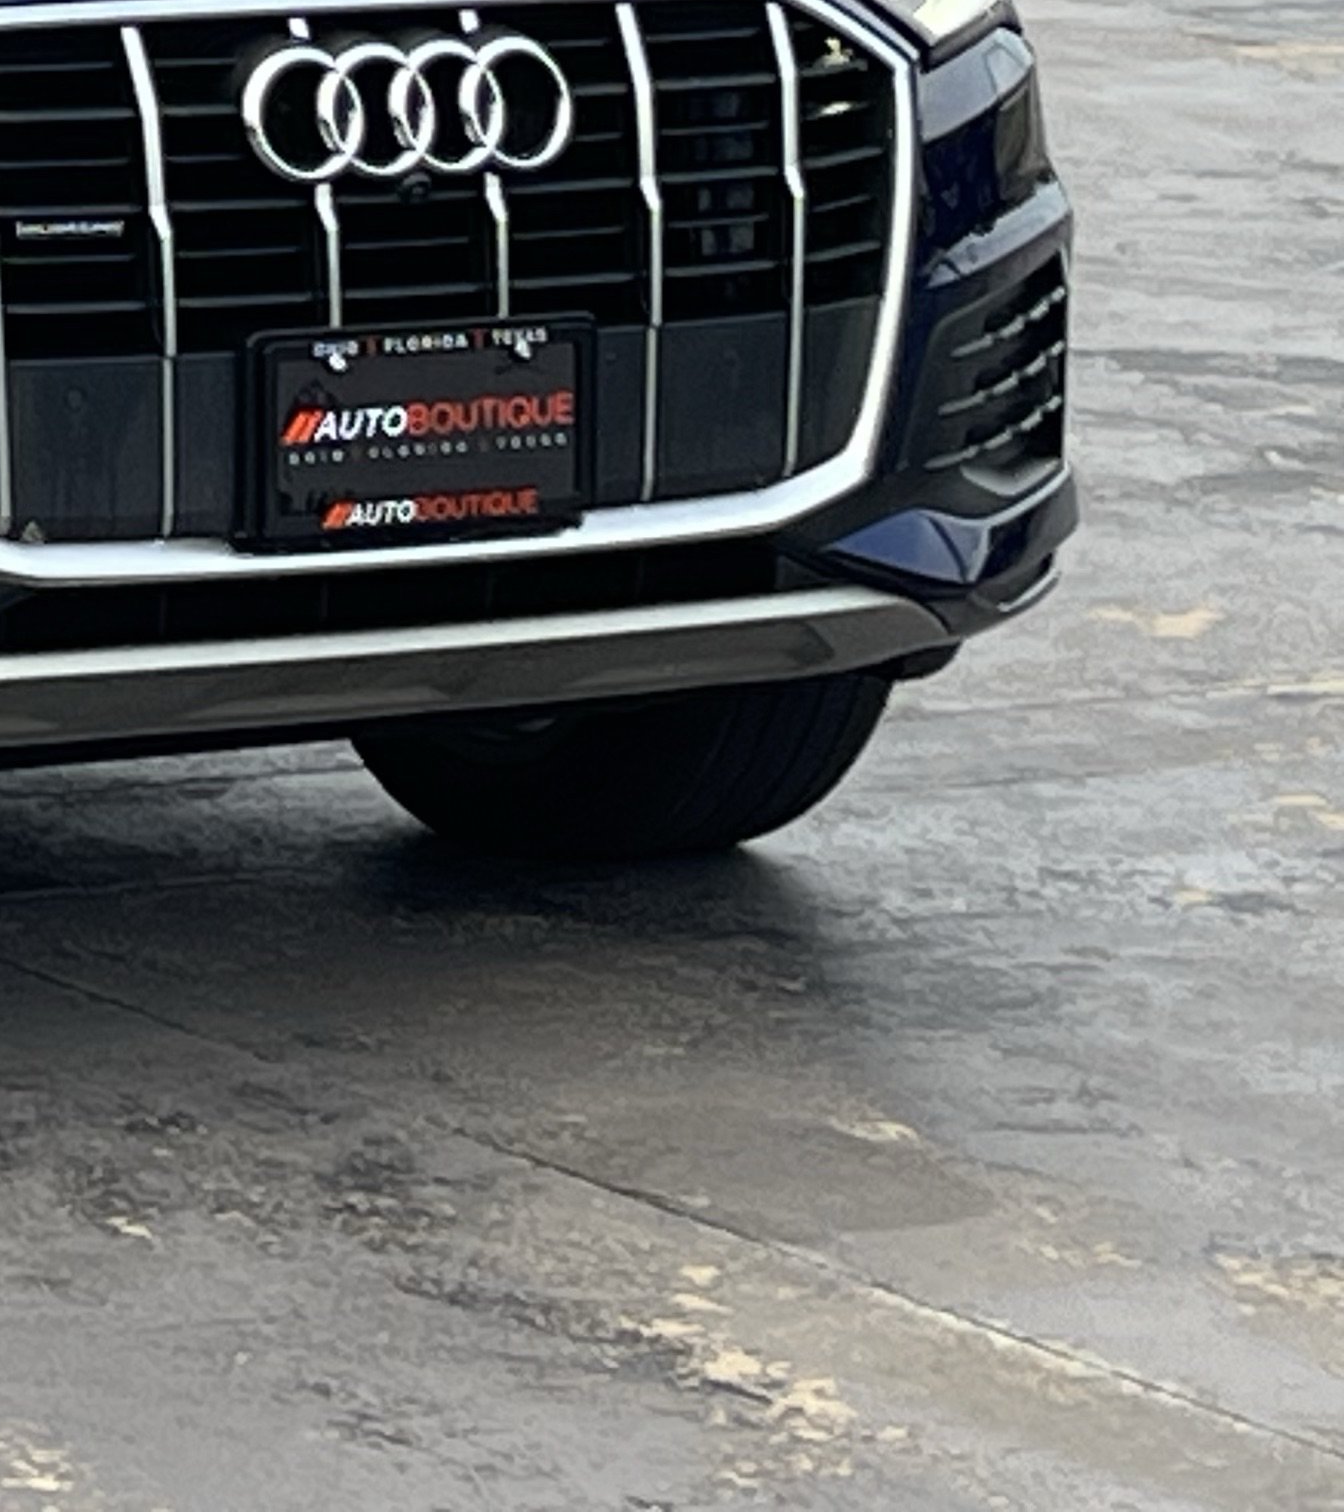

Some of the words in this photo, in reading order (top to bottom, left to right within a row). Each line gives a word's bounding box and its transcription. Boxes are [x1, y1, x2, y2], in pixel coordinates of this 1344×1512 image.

[383, 332, 469, 355] FLORIDA
[314, 391, 574, 443] AUTOBOUTIQUE
[345, 488, 538, 527] AUTOBOUTIQUE
